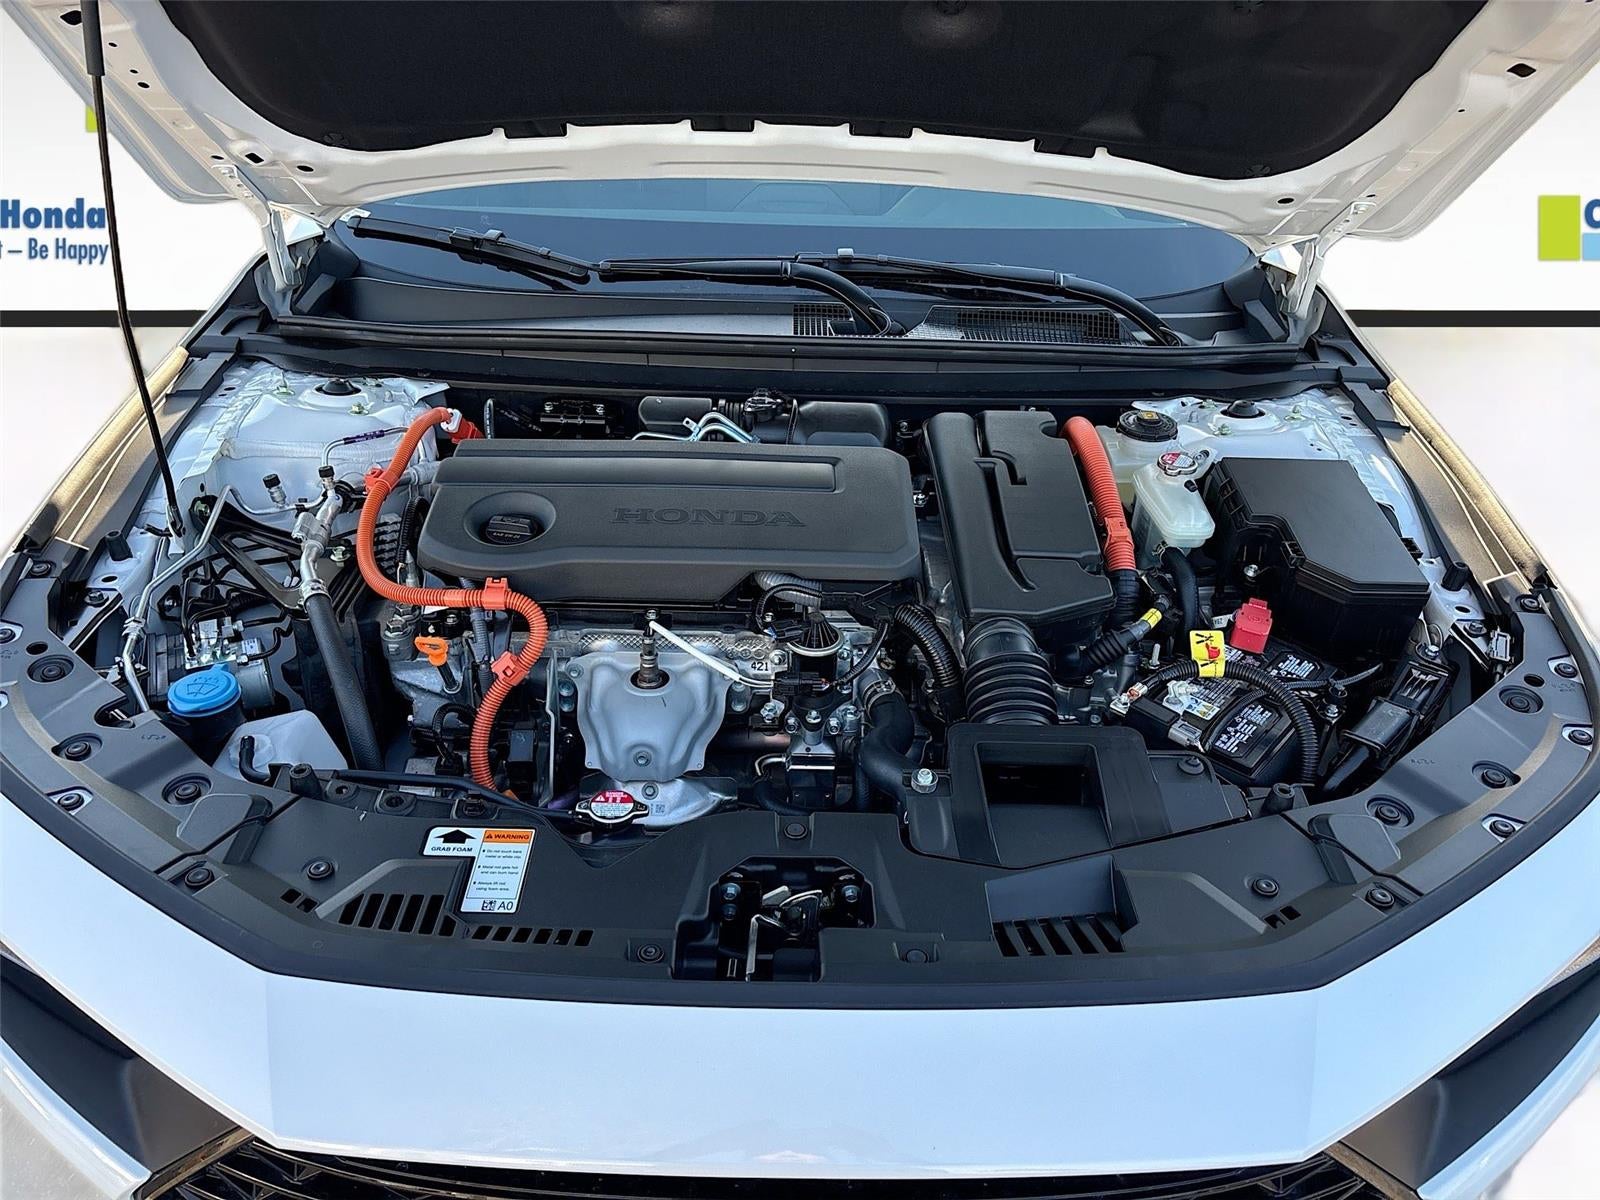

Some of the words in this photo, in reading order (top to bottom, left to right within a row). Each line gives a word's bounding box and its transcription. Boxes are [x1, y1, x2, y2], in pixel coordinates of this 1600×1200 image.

[0, 197, 106, 229] Honda
[28, 237, 49, 260] Be
[55, 237, 109, 265] Happy
[611, 507, 806, 528] HONDA
[751, 661, 769, 672] 421
[497, 901, 514, 911] A0
